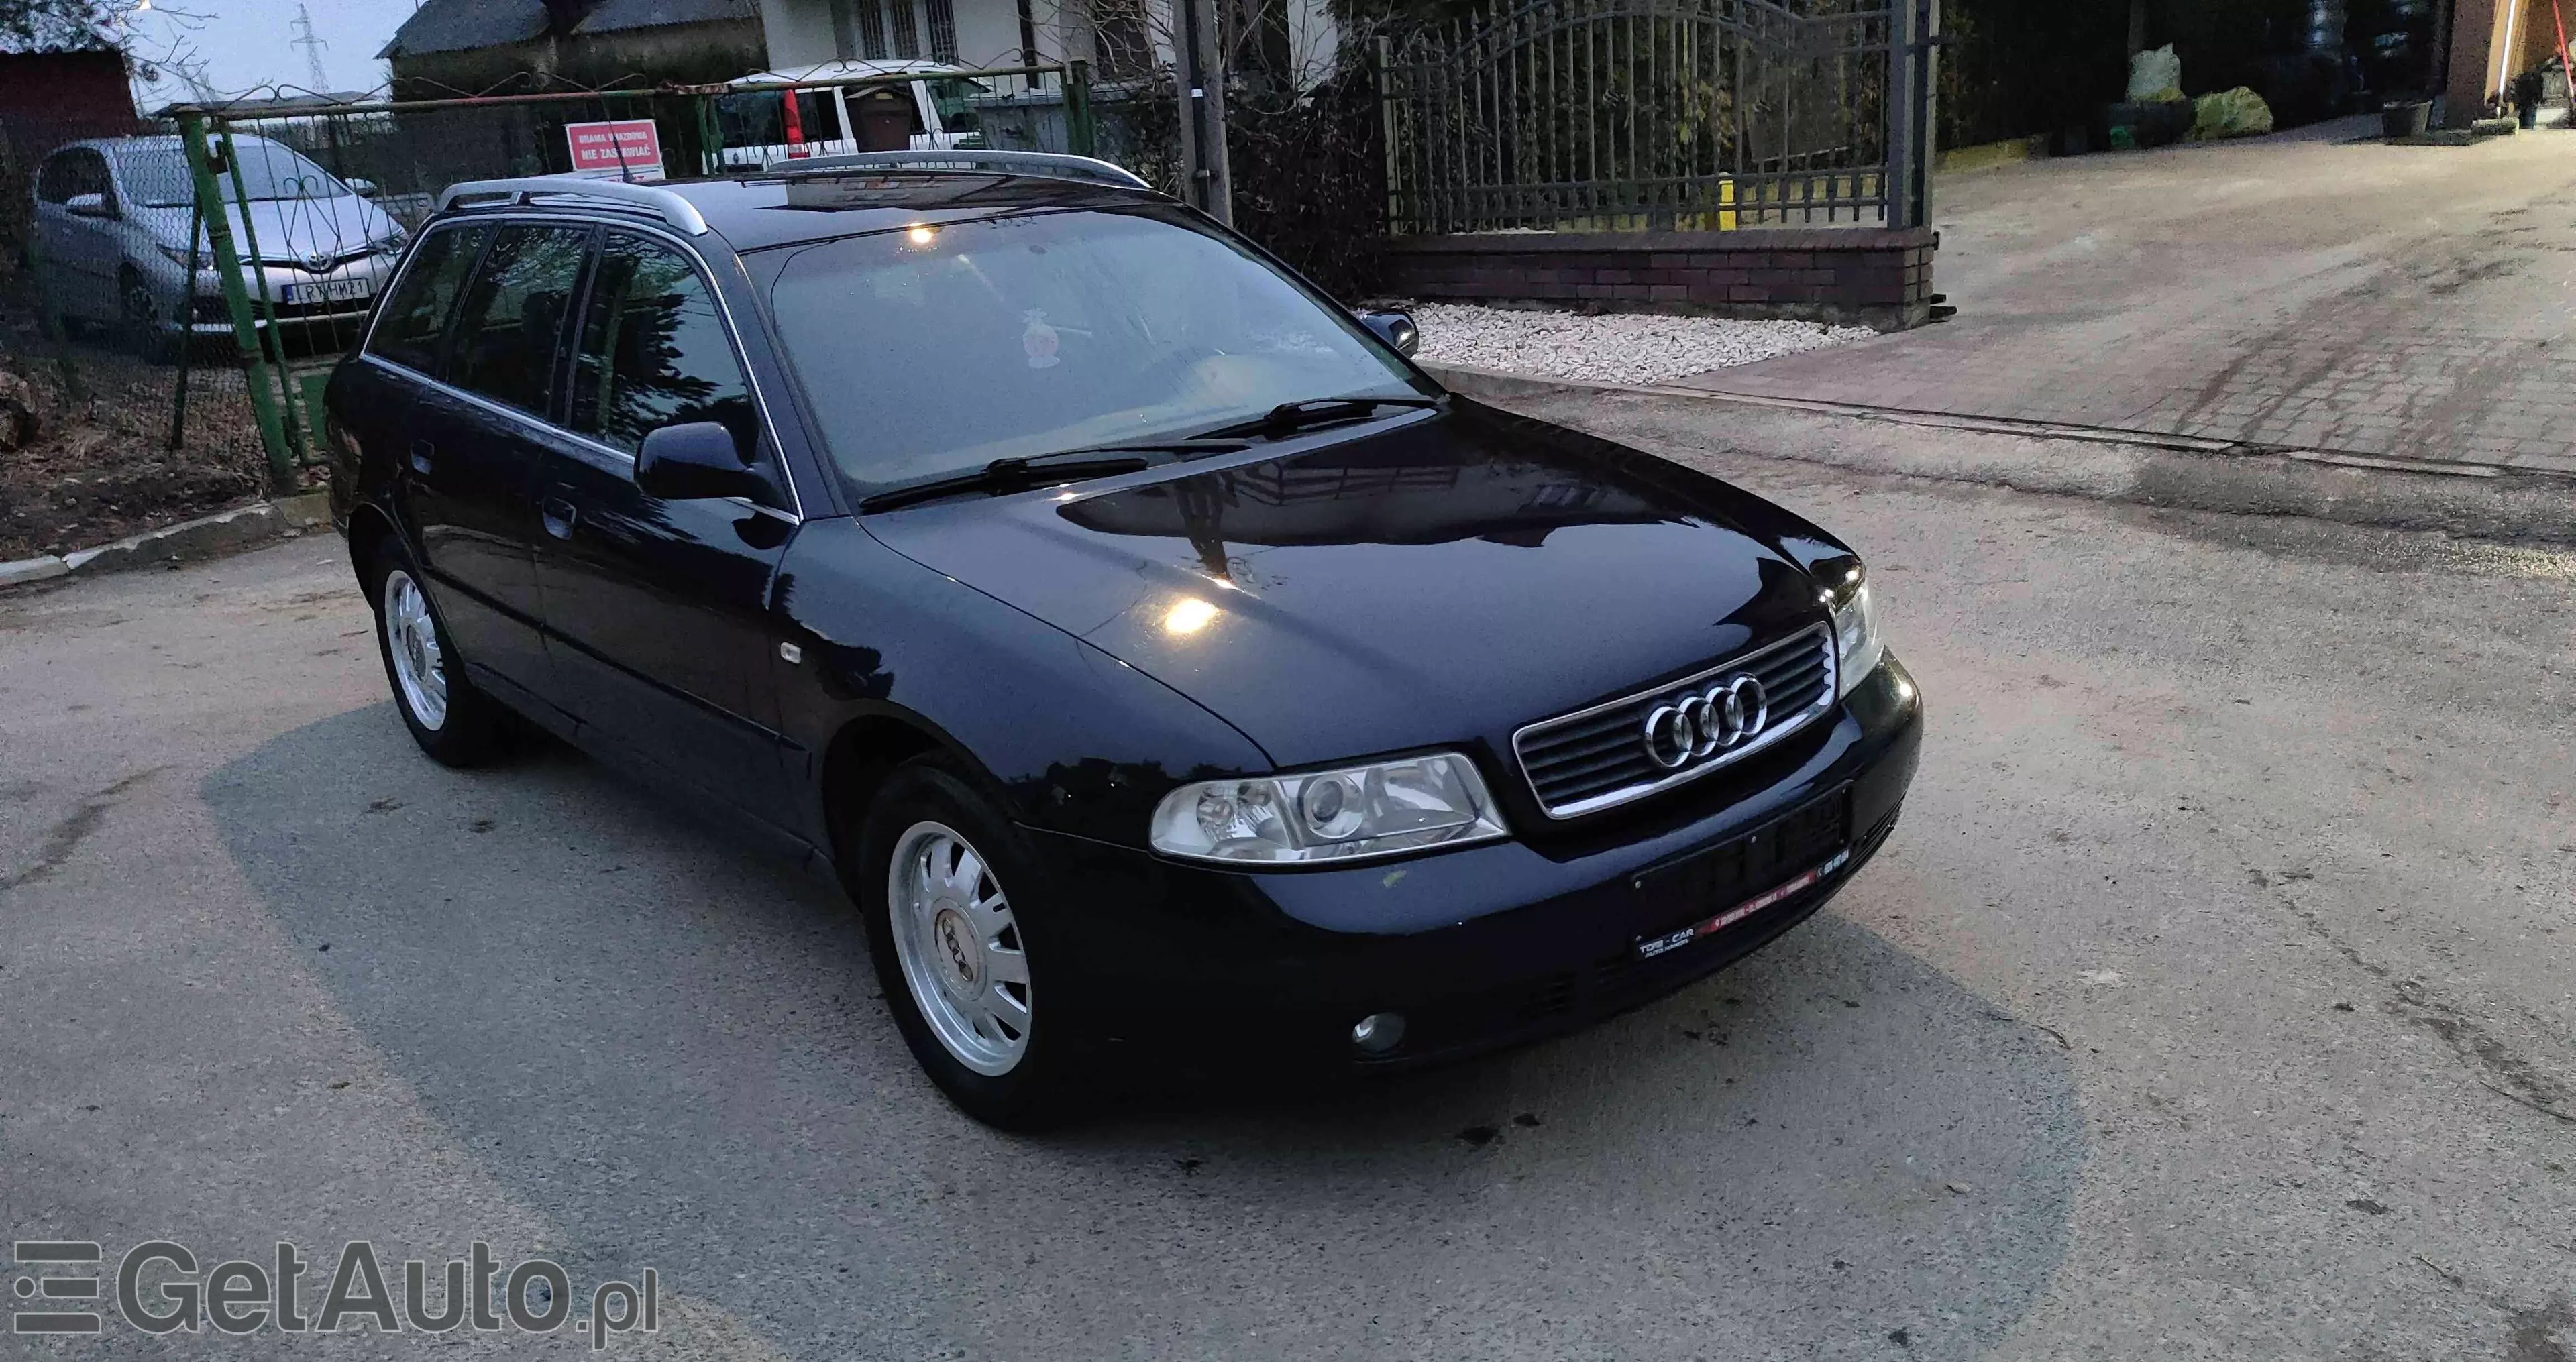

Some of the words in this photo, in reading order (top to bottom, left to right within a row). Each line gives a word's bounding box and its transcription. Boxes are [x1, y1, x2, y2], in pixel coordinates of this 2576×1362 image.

[582, 149, 598, 160] NIE
[600, 144, 651, 159] ZASAWIAĆ
[1672, 929, 1694, 942] CAR
